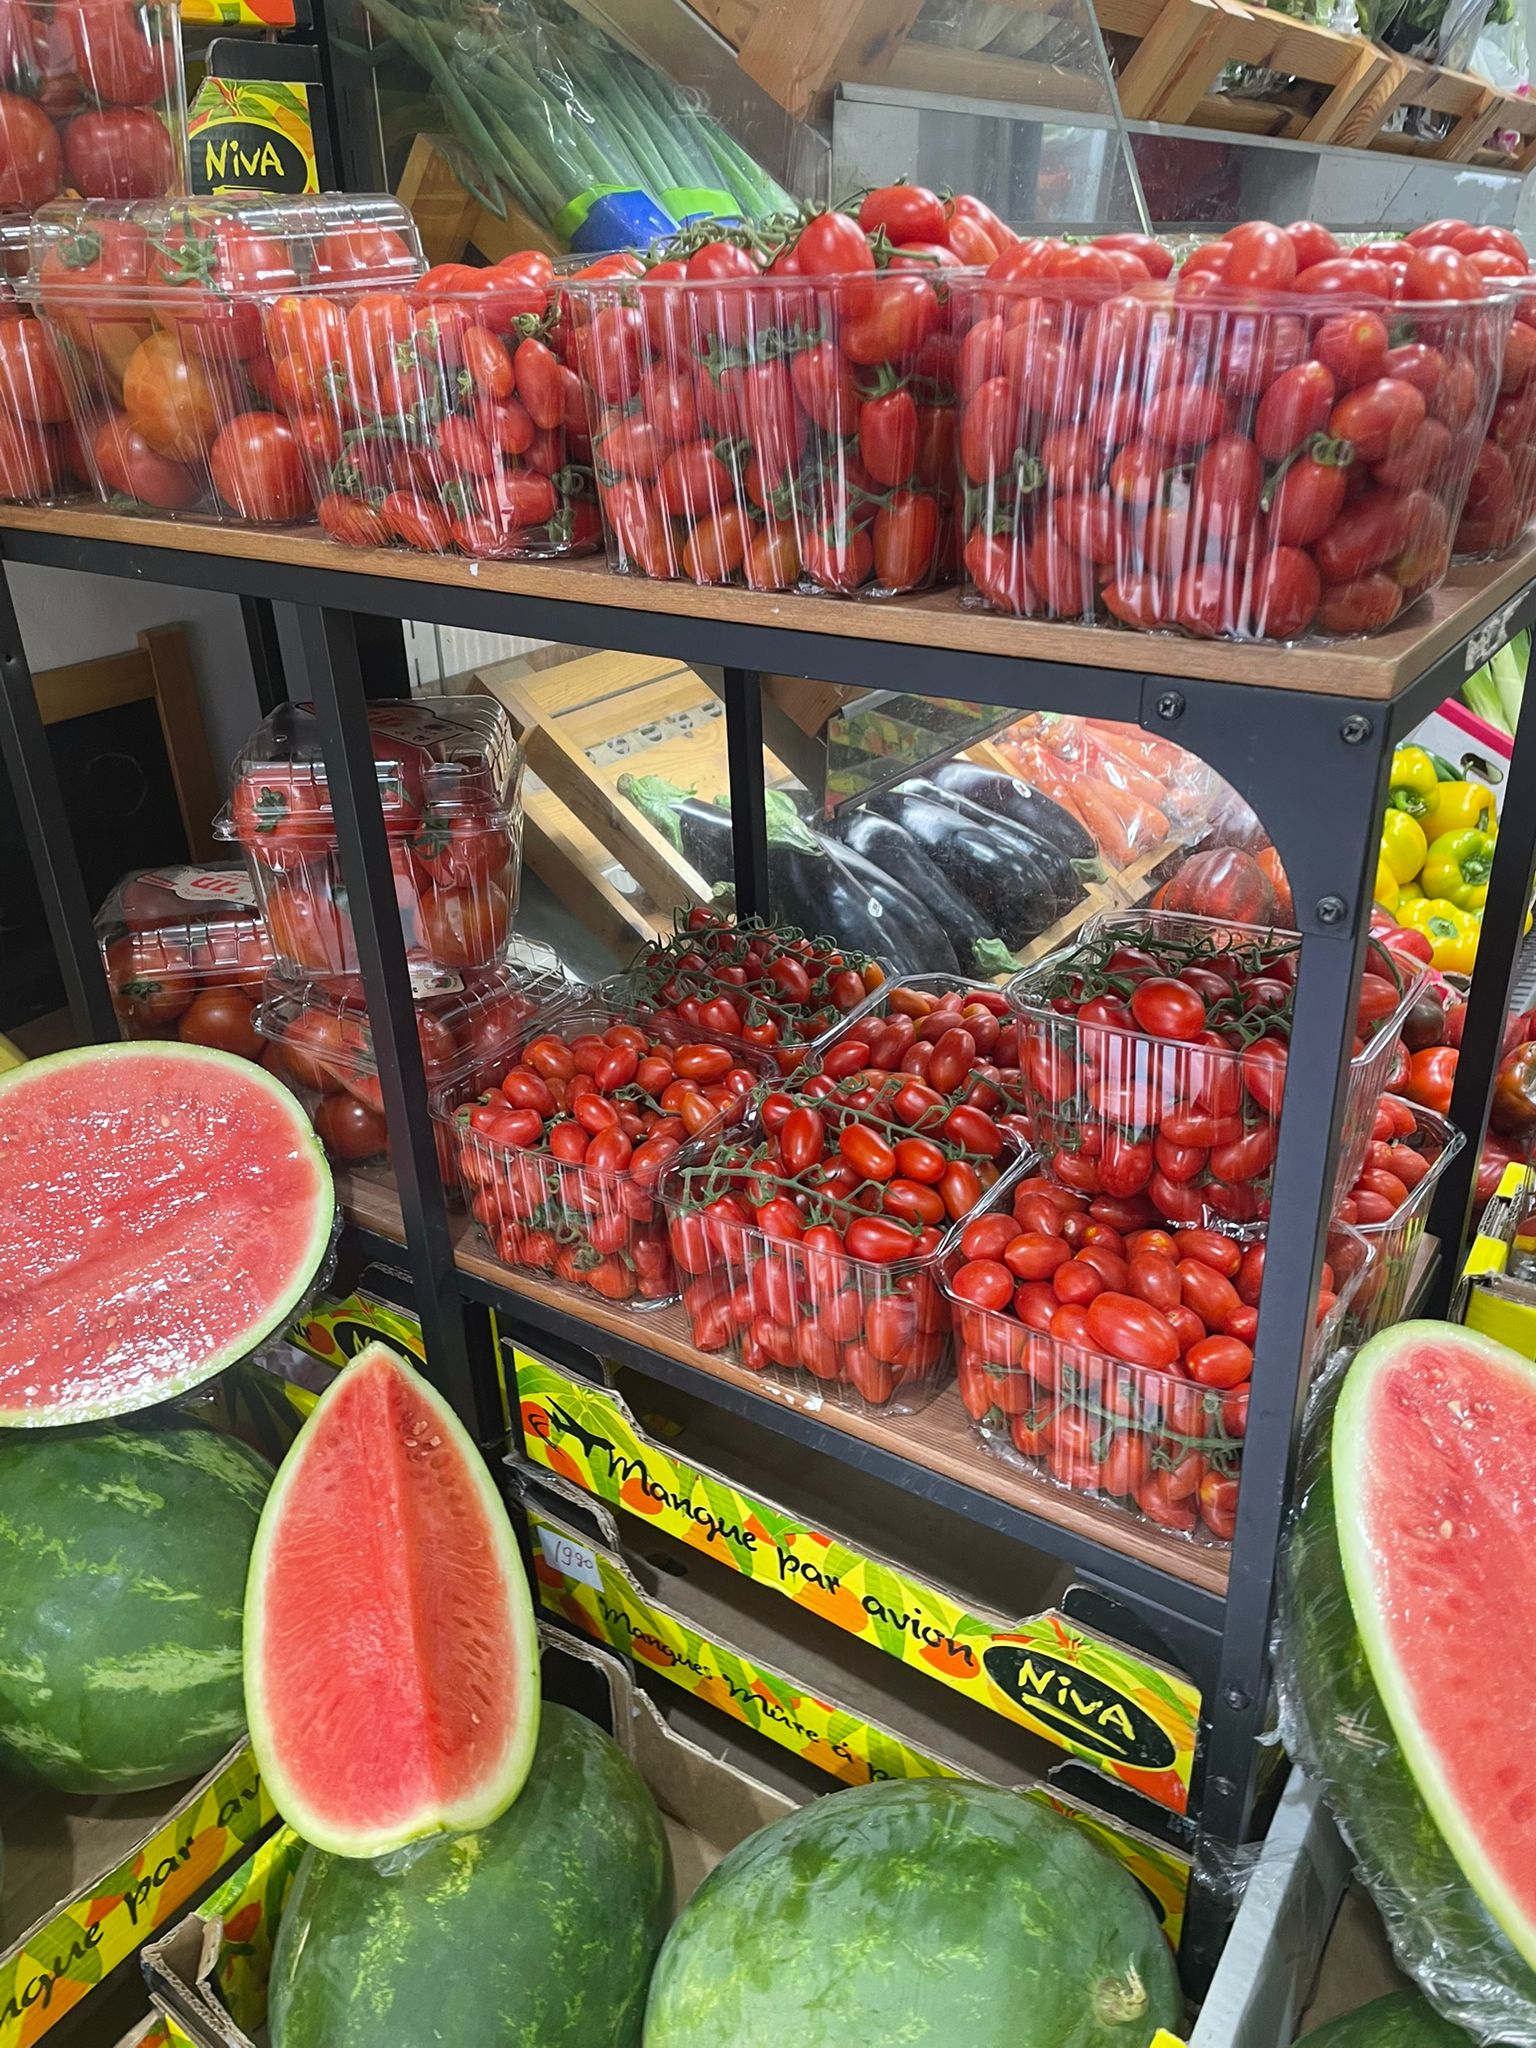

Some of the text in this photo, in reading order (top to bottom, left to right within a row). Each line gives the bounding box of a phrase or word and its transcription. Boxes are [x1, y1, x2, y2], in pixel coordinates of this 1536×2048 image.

[608, 1449, 974, 1667] Mangue par avion
[0, 1835, 195, 2030] ngue par
